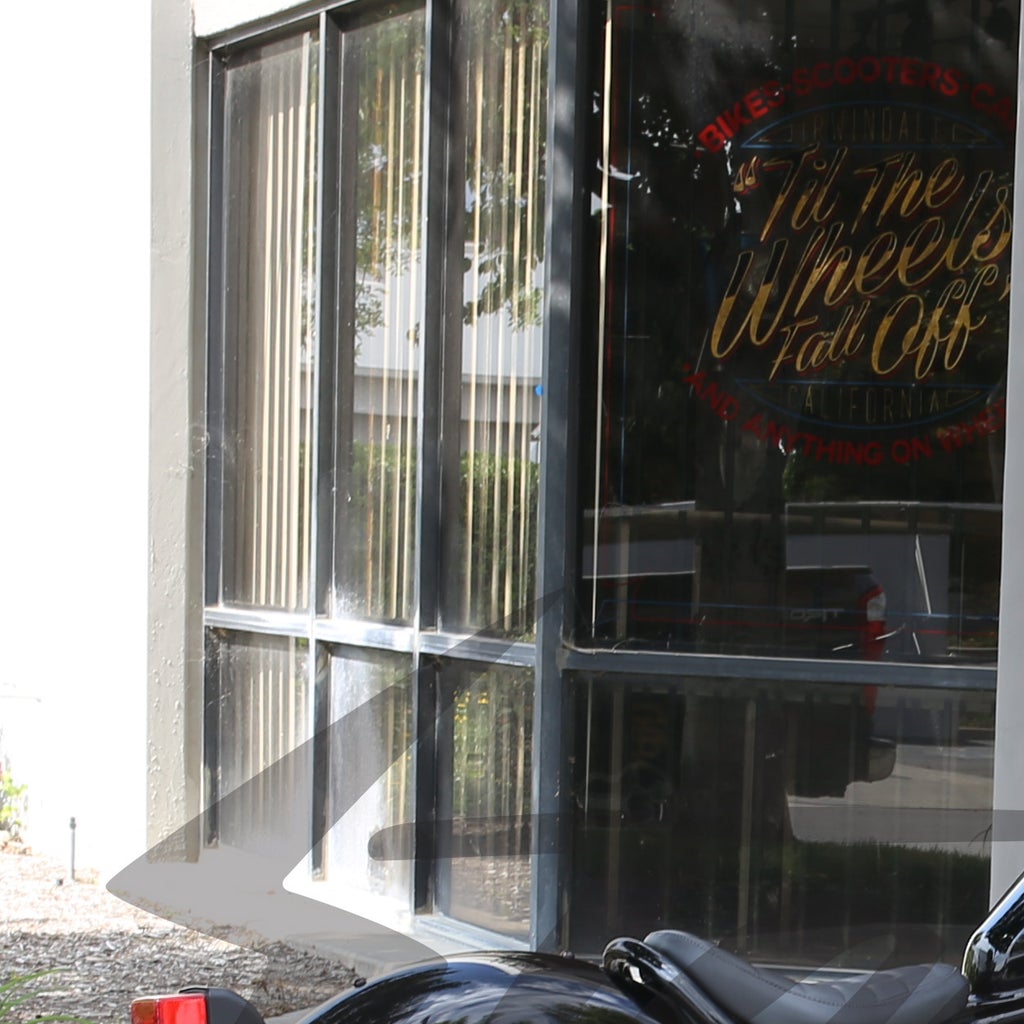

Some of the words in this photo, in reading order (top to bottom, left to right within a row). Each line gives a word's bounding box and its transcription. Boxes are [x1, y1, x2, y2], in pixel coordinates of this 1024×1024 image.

[698, 81, 787, 155] BIKES
[791, 56, 960, 96] SCOOTERS
[971, 81, 1016, 130] CA
[851, 152, 967, 236] The
[709, 169, 1012, 360] Wheels
[768, 300, 871, 383] Fall
[688, 369, 740, 422] AND
[742, 413, 884, 468] ANYTHING
[891, 438, 935, 464] ON
[786, 384, 942, 422] CALIFORNIA
